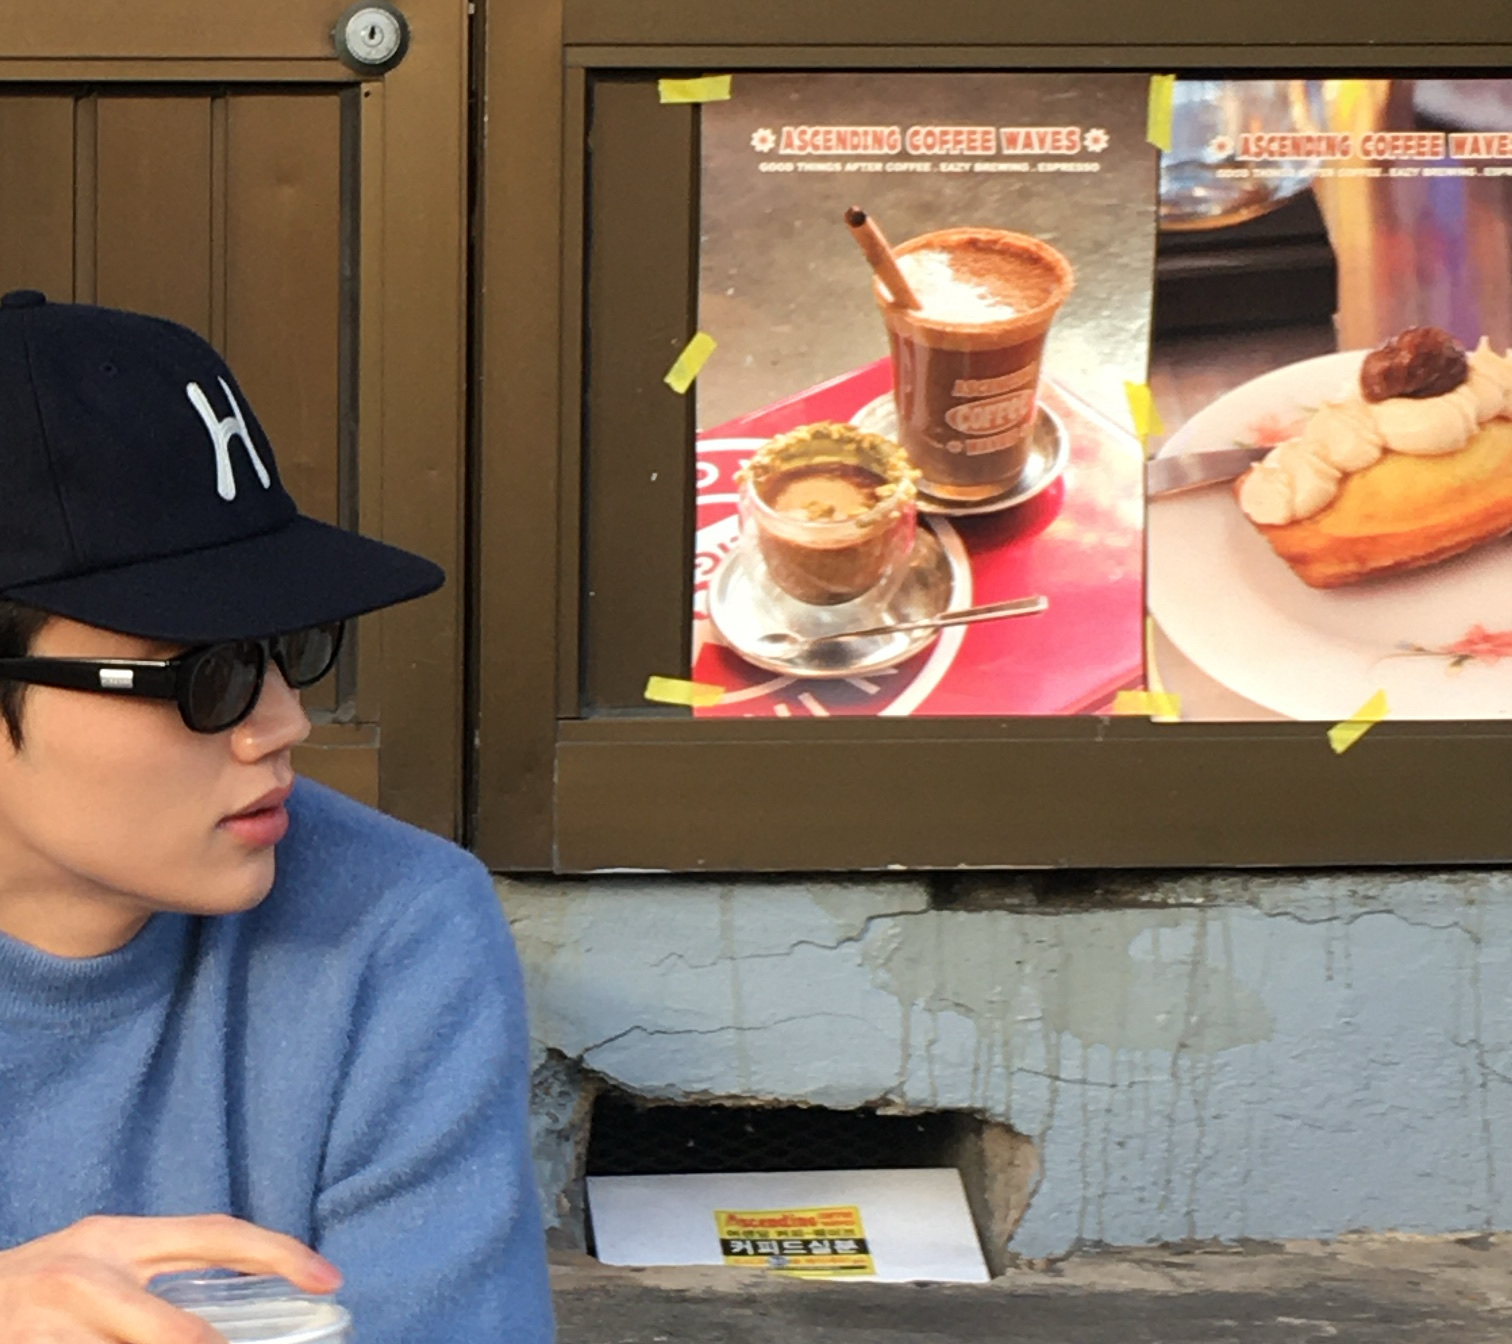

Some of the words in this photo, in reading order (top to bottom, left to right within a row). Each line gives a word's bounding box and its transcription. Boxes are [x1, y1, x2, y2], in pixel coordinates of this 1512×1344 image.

[779, 126, 902, 155] ASCENDING
[905, 126, 997, 155] COFFEE
[999, 126, 1081, 155] WAVES
[1448, 131, 1512, 159] WAVE
